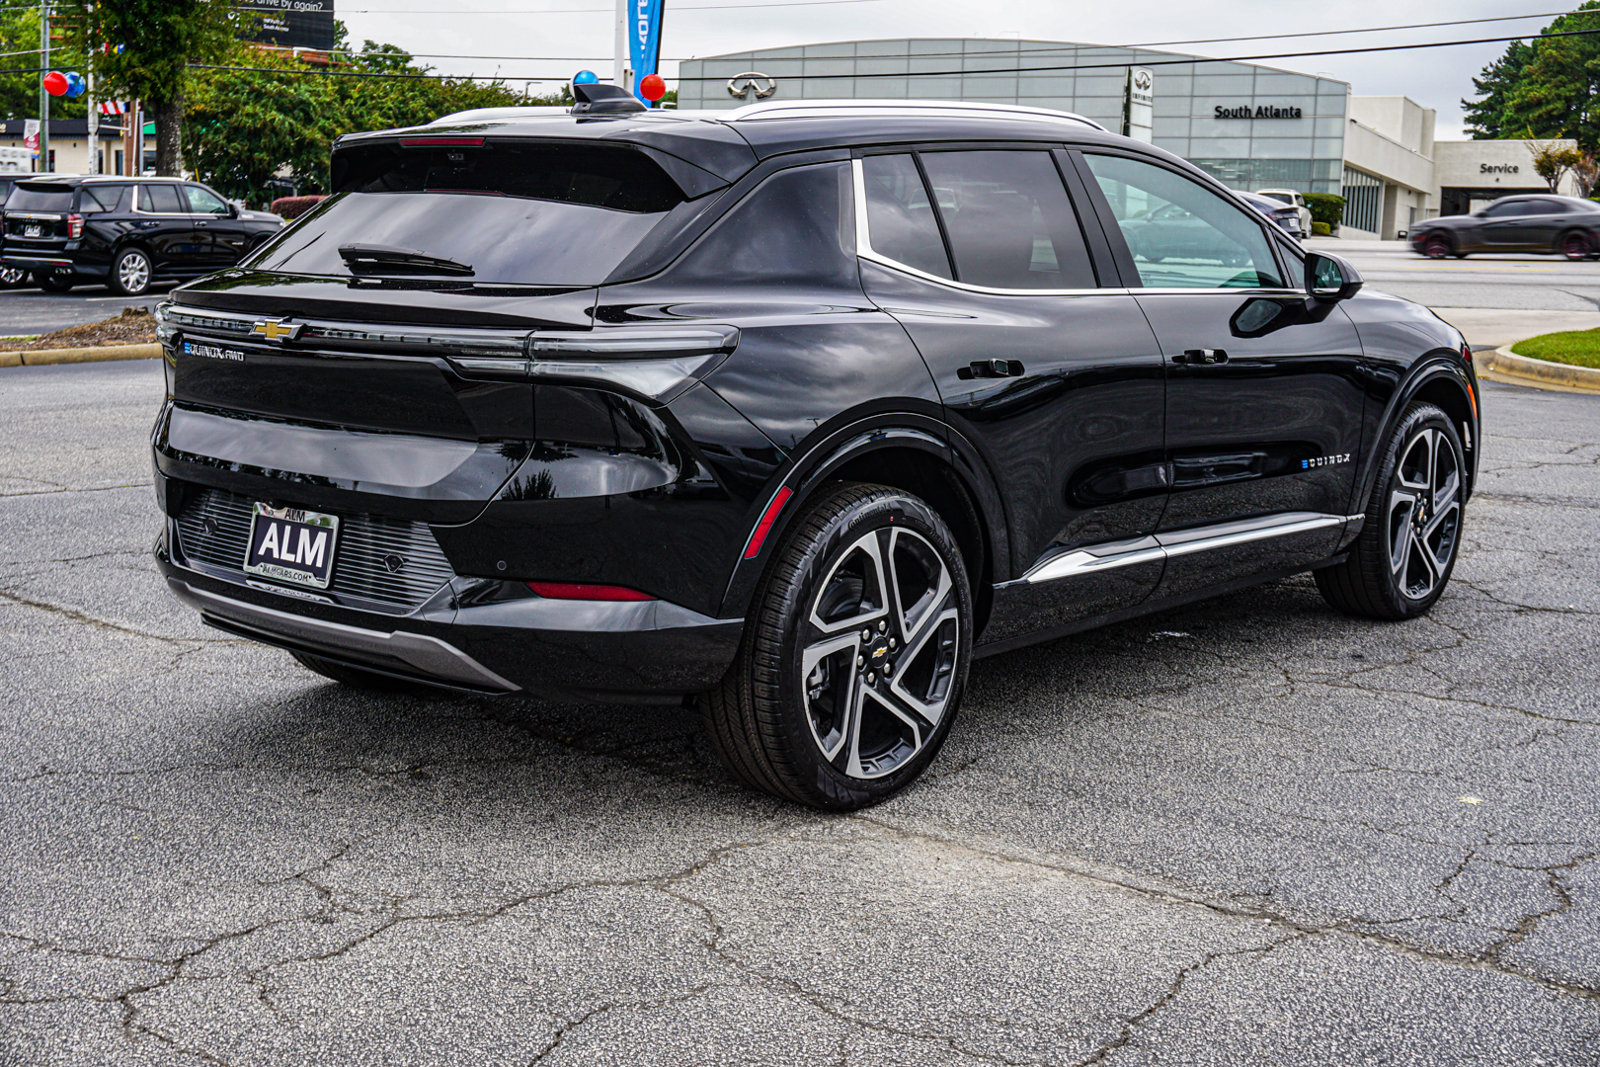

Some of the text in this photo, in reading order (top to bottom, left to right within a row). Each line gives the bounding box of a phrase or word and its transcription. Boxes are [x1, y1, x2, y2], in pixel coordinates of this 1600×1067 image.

[281, 0, 292, 10] by
[294, 1, 323, 12] again?
[1215, 105, 1302, 119] South Atlanta
[1480, 163, 1519, 174] Service
[184, 342, 224, 359] EQUINOX
[1301, 453, 1351, 469] EQUINOX
[284, 508, 306, 523] ALM
[258, 522, 328, 568] ALM
